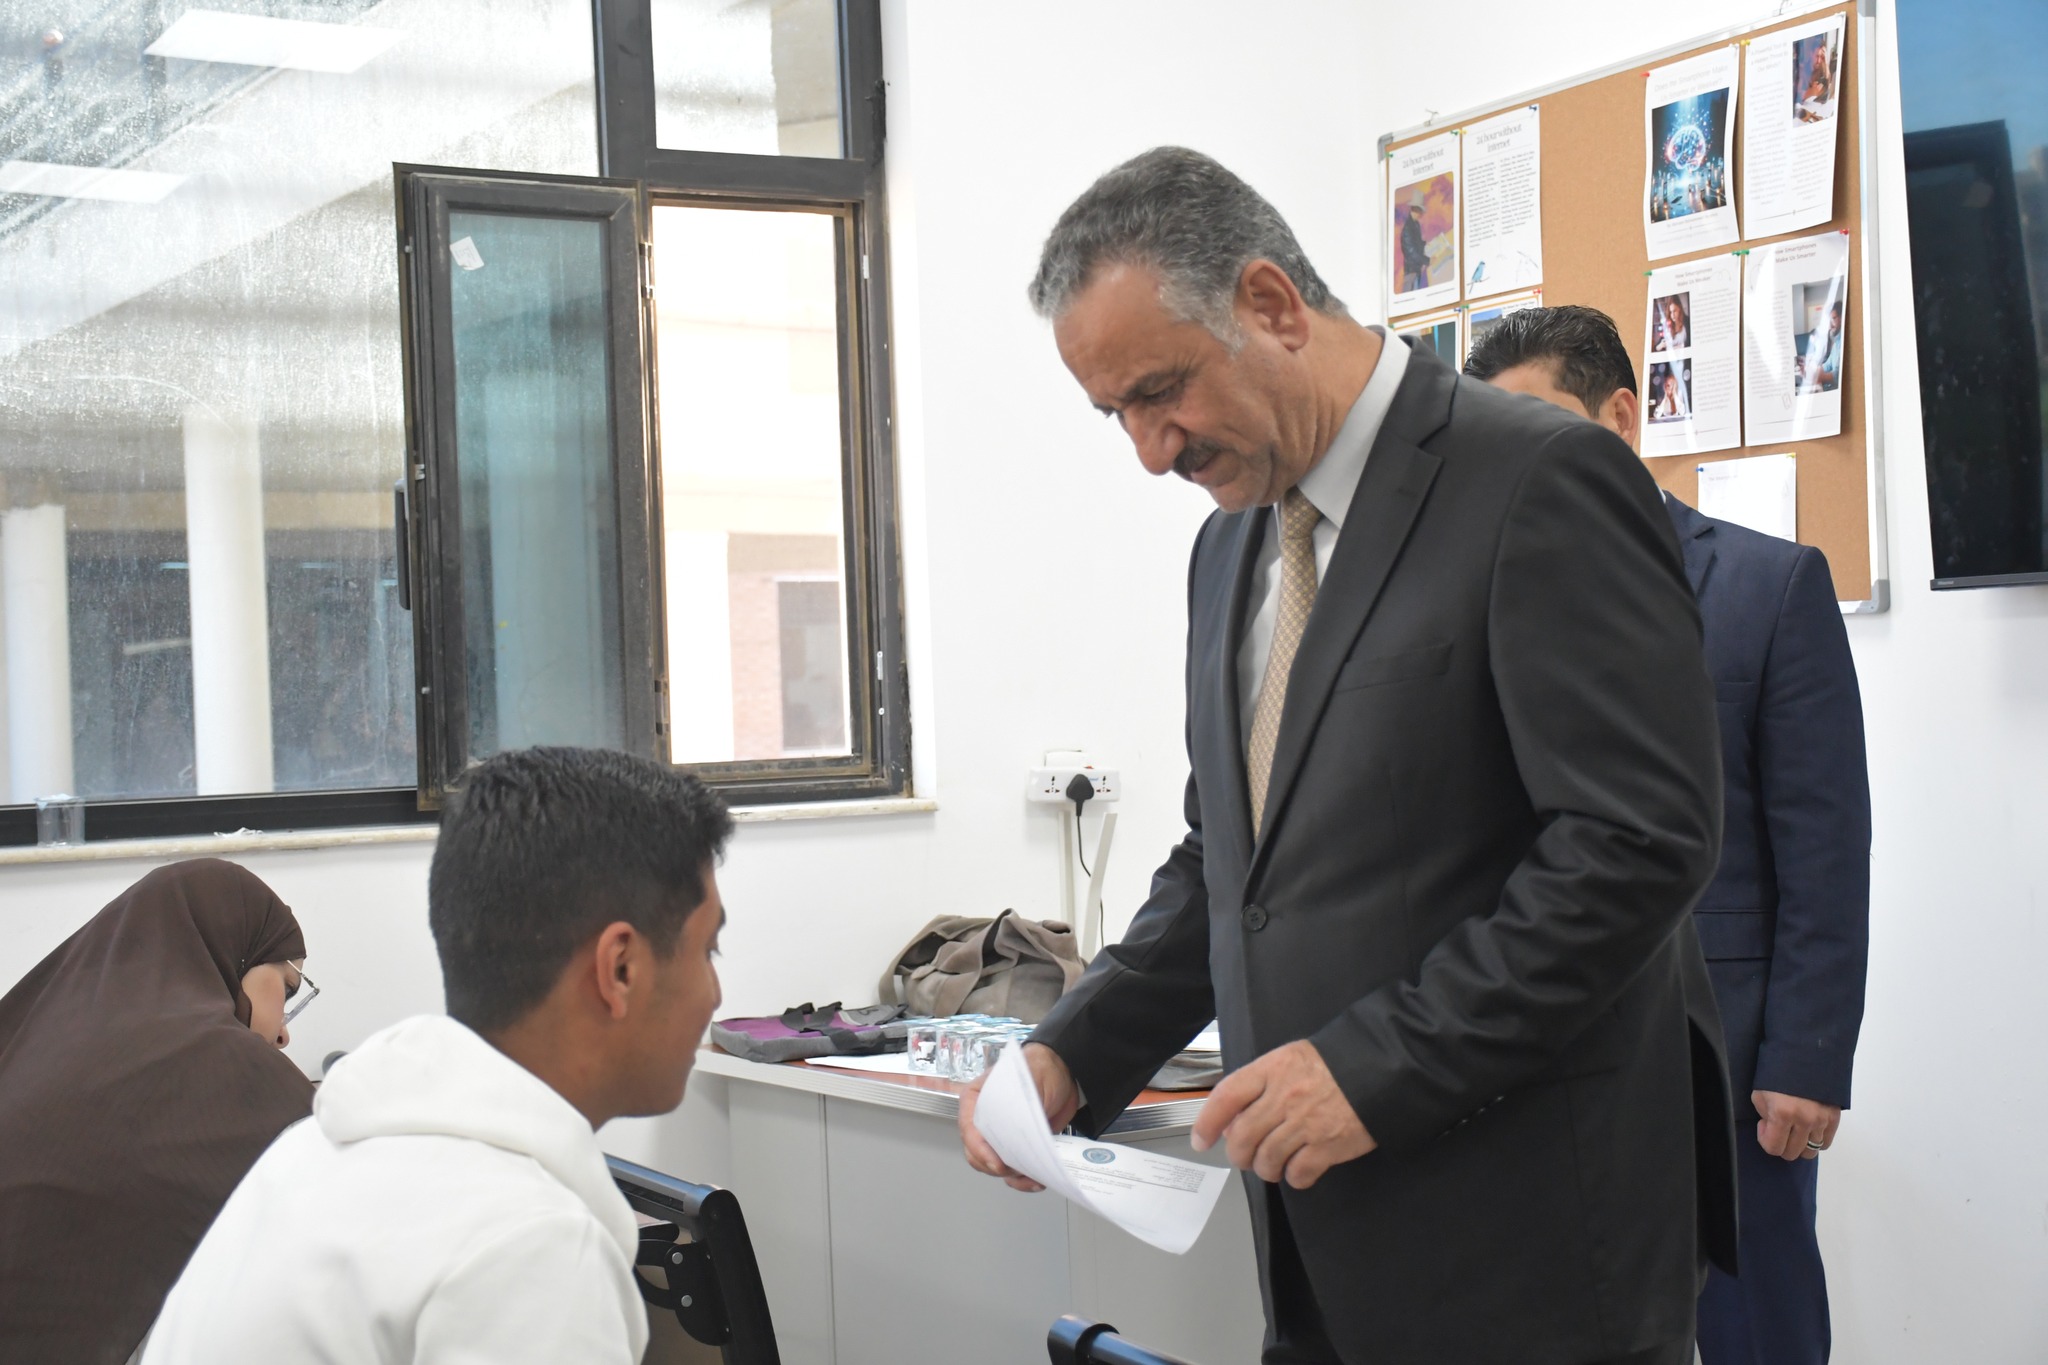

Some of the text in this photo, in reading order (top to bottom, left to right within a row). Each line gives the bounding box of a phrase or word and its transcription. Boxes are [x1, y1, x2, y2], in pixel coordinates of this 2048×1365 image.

[1784, 243, 1817, 253] Smartphones
[1775, 256, 1789, 264] Make
[1796, 251, 1816, 260] Smarter
